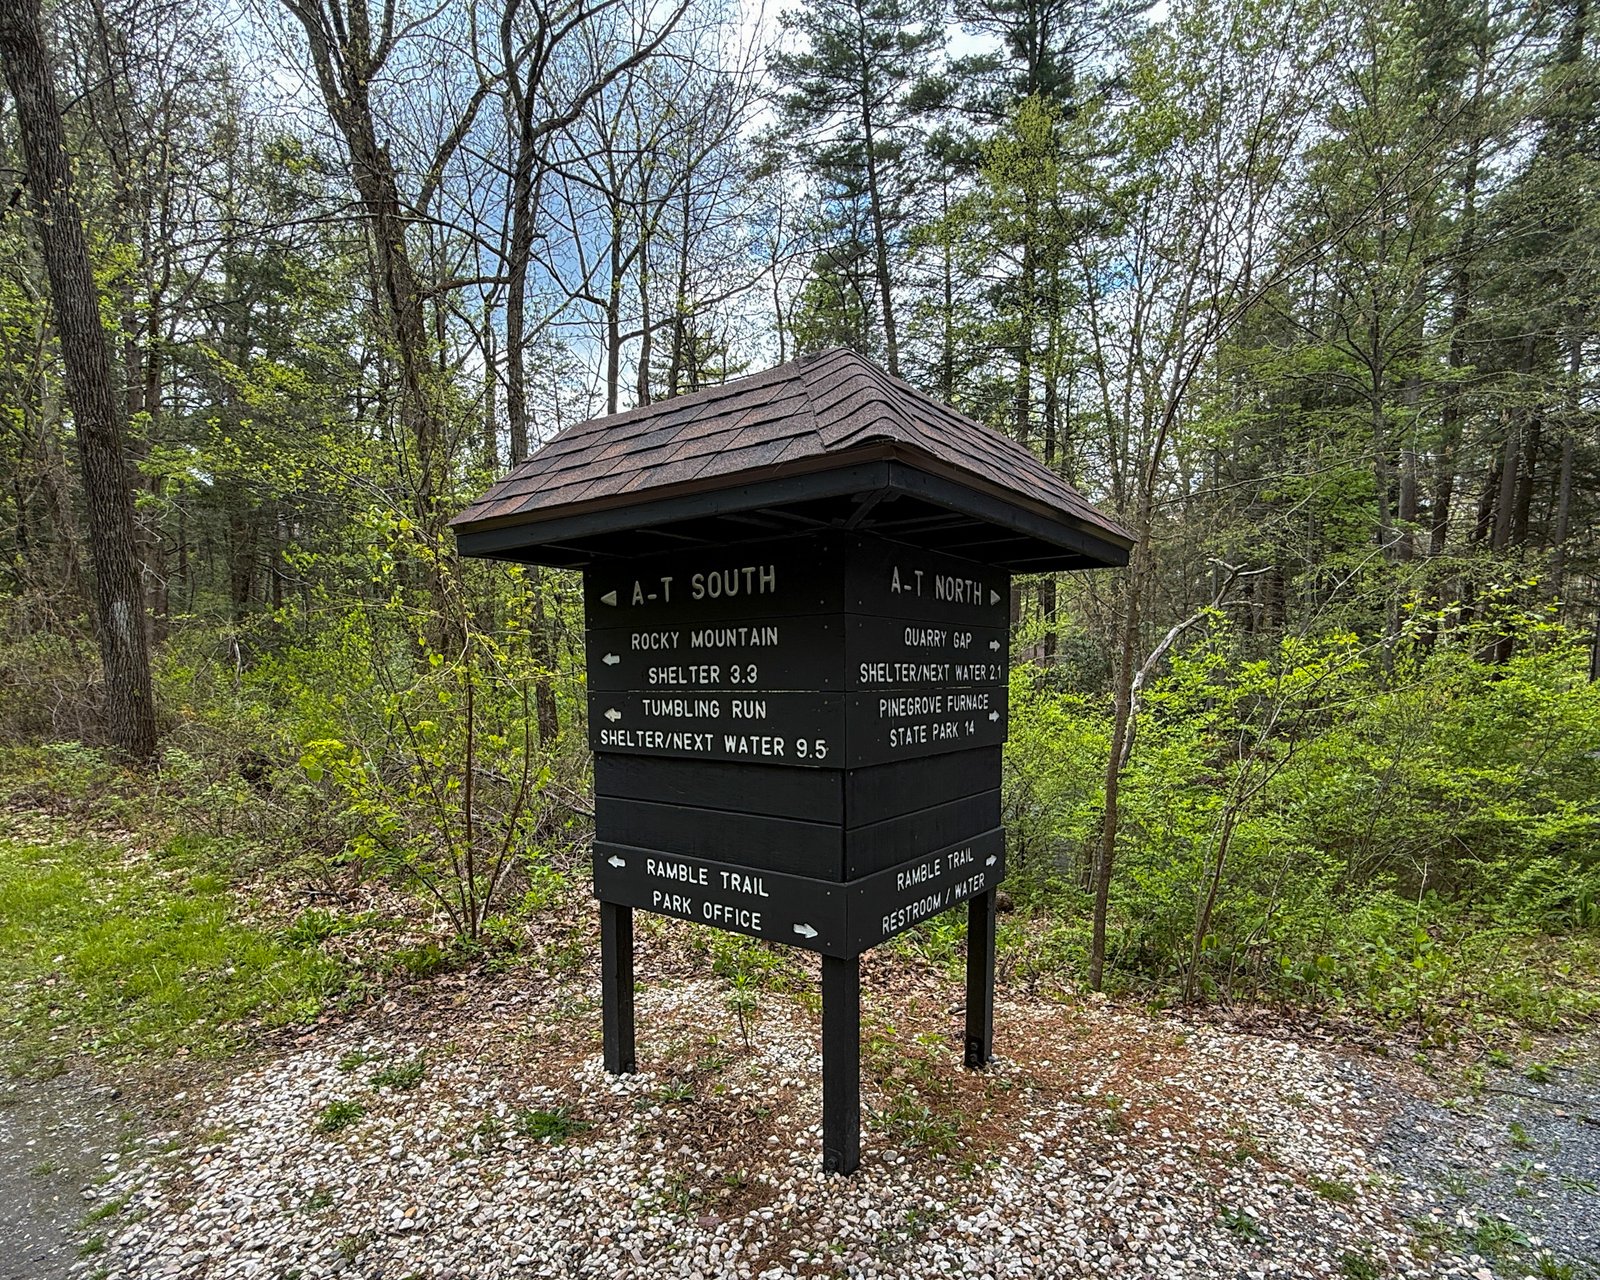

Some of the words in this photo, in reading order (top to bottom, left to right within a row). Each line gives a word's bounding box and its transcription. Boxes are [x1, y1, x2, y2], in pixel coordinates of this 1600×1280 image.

[632, 577, 674, 606] A-T
[690, 566, 776, 599] SOUTH
[890, 565, 923, 596] A-T
[934, 575, 983, 605] NORTH
[630, 631, 680, 651] ROCKY
[691, 626, 779, 648] MOUNTAIN
[904, 627, 947, 648] QUARRY
[953, 631, 973, 649] GAP
[648, 665, 720, 685] SHELTER
[729, 664, 758, 685] 3.3
[859, 662, 950, 683] SHELTER/NEXT
[955, 663, 987, 681] WATER
[989, 664, 1002, 681] 2.1
[642, 699, 720, 719] TUMBLING
[731, 699, 767, 720] RUN
[879, 695, 942, 718] PINEGROVE
[946, 693, 989, 712] FURNACE
[600, 729, 714, 750] SHELTER/NEXT
[724, 734, 786, 758] WATER
[795, 738, 828, 761] 9.5
[890, 725, 927, 748] STATE
[932, 722, 959, 741] PARK
[964, 720, 975, 737] 14
[646, 858, 709, 882] RAMBLE
[719, 871, 770, 898] TRAIL
[896, 858, 941, 892] RAMBLE
[947, 847, 974, 870] TRAIL
[652, 890, 693, 915] PARK
[703, 901, 762, 931] OFFICE
[882, 891, 942, 935] RESTROOM
[945, 887, 951, 905] /
[955, 872, 985, 900] WATER
